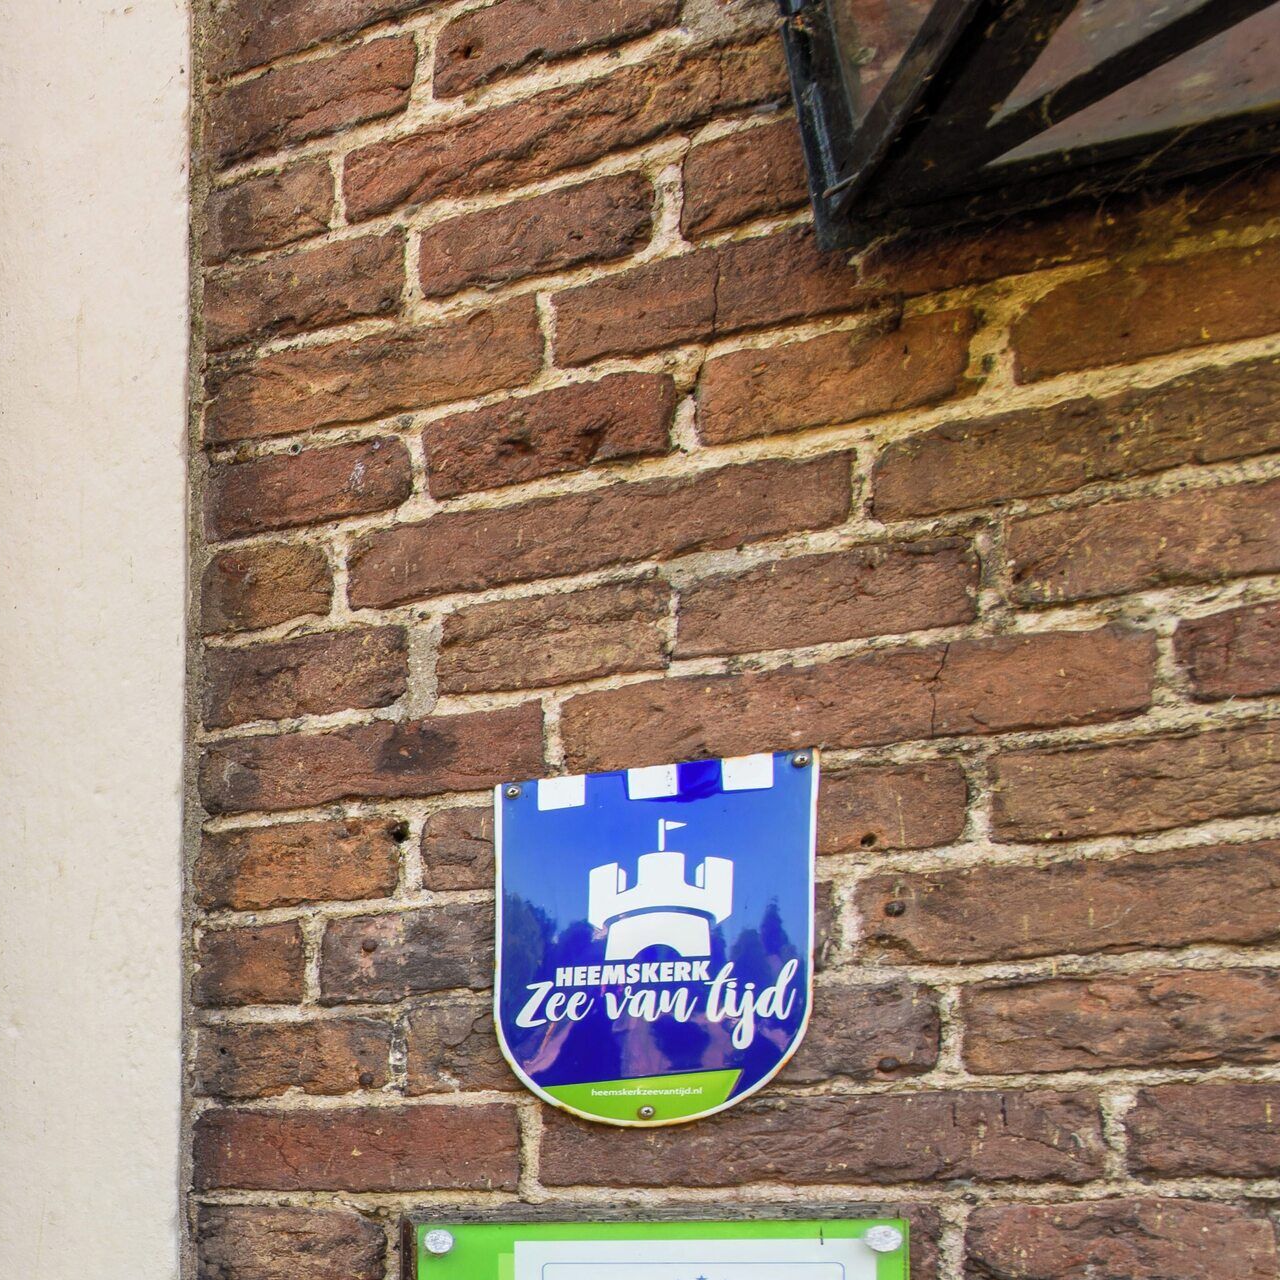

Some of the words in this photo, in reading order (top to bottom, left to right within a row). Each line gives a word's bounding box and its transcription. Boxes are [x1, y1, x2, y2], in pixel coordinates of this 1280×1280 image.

[555, 960, 711, 987] HEEMSKERK
[515, 981, 594, 1028] Zee
[605, 985, 698, 1022] van
[704, 958, 798, 1050] tijd
[591, 1086, 703, 1097] heemskerkzeevantijd.nl
